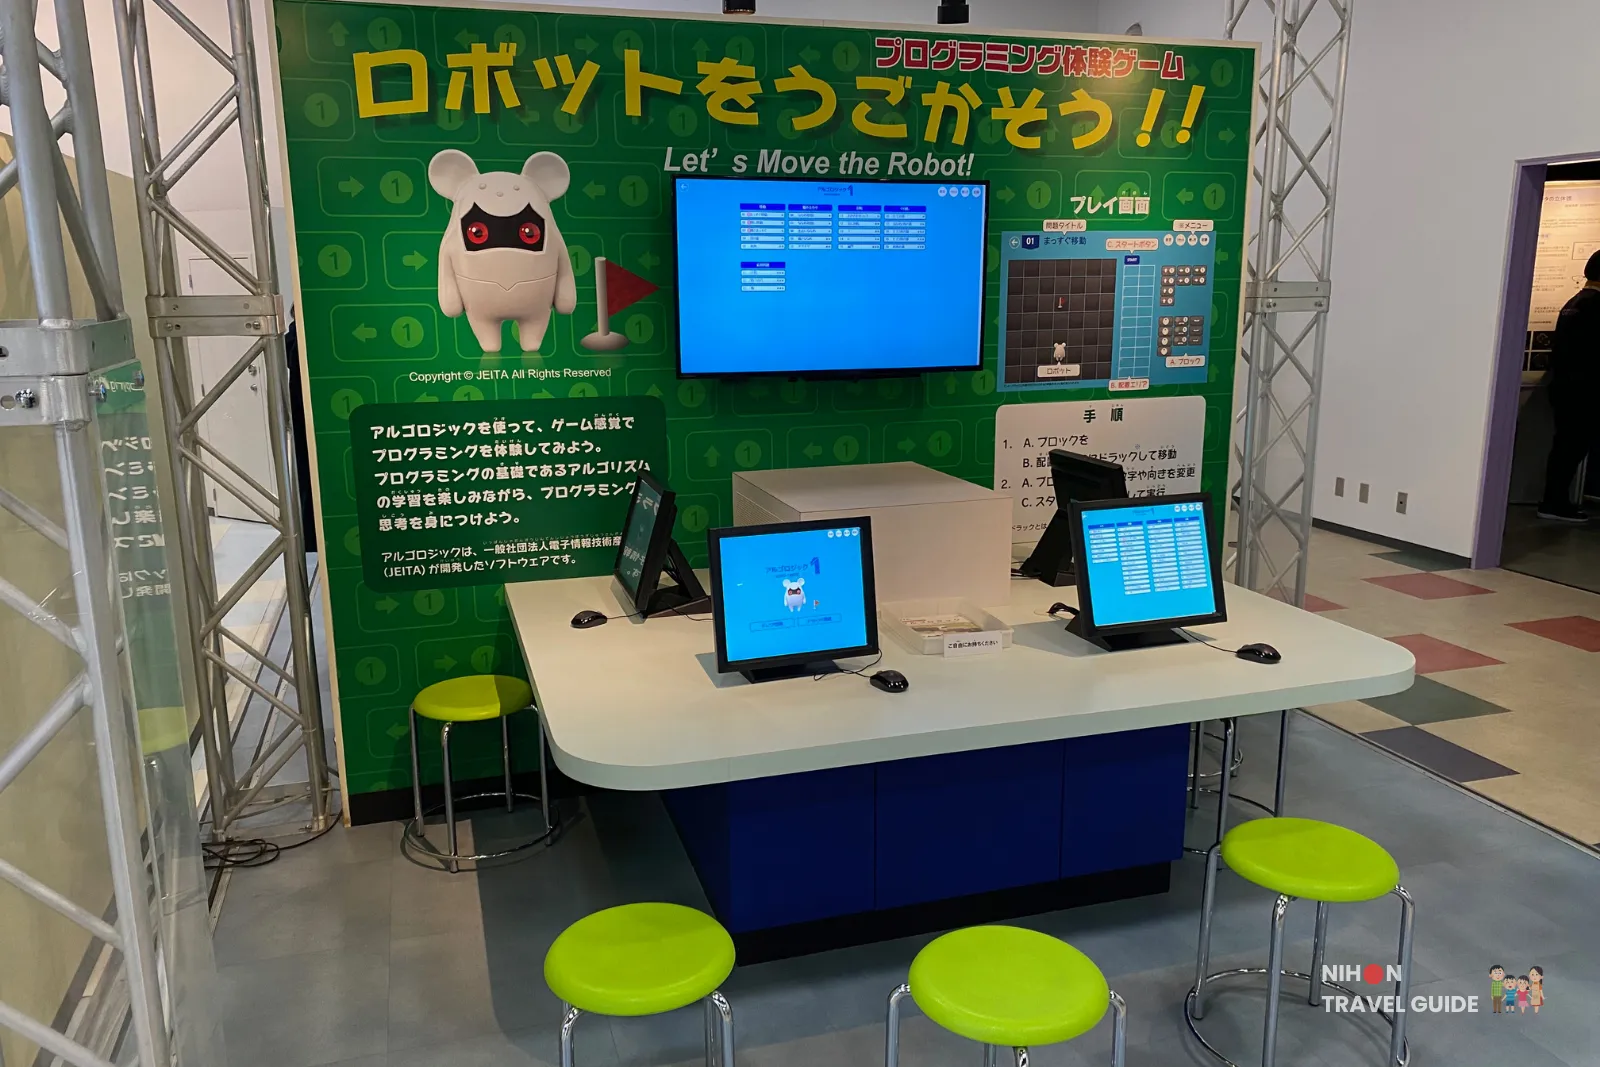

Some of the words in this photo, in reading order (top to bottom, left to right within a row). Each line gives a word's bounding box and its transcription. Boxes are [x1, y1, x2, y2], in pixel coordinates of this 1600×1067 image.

[874, 37, 1185, 81] プログラミング体験ゲーム
[353, 42, 1207, 150] ロボットをうごかそう!!
[757, 149, 830, 174] Move
[838, 150, 880, 175] the
[887, 152, 975, 177] Robot!
[1070, 195, 1151, 216] プレイ画面
[1026, 236, 1035, 246] 01
[1043, 236, 1087, 246] まっすぐ移動
[408, 369, 462, 383] Copyright
[476, 368, 509, 381] JEITA
[511, 368, 525, 380] All
[527, 367, 561, 381] Rights
[563, 366, 612, 379] Reserved
[370, 416, 635, 440] アルゴロジックを使って、ゲーム感覚で
[372, 441, 602, 462] プログラミングを体験してみよう。
[378, 511, 521, 532] 思考を身につけよう。
